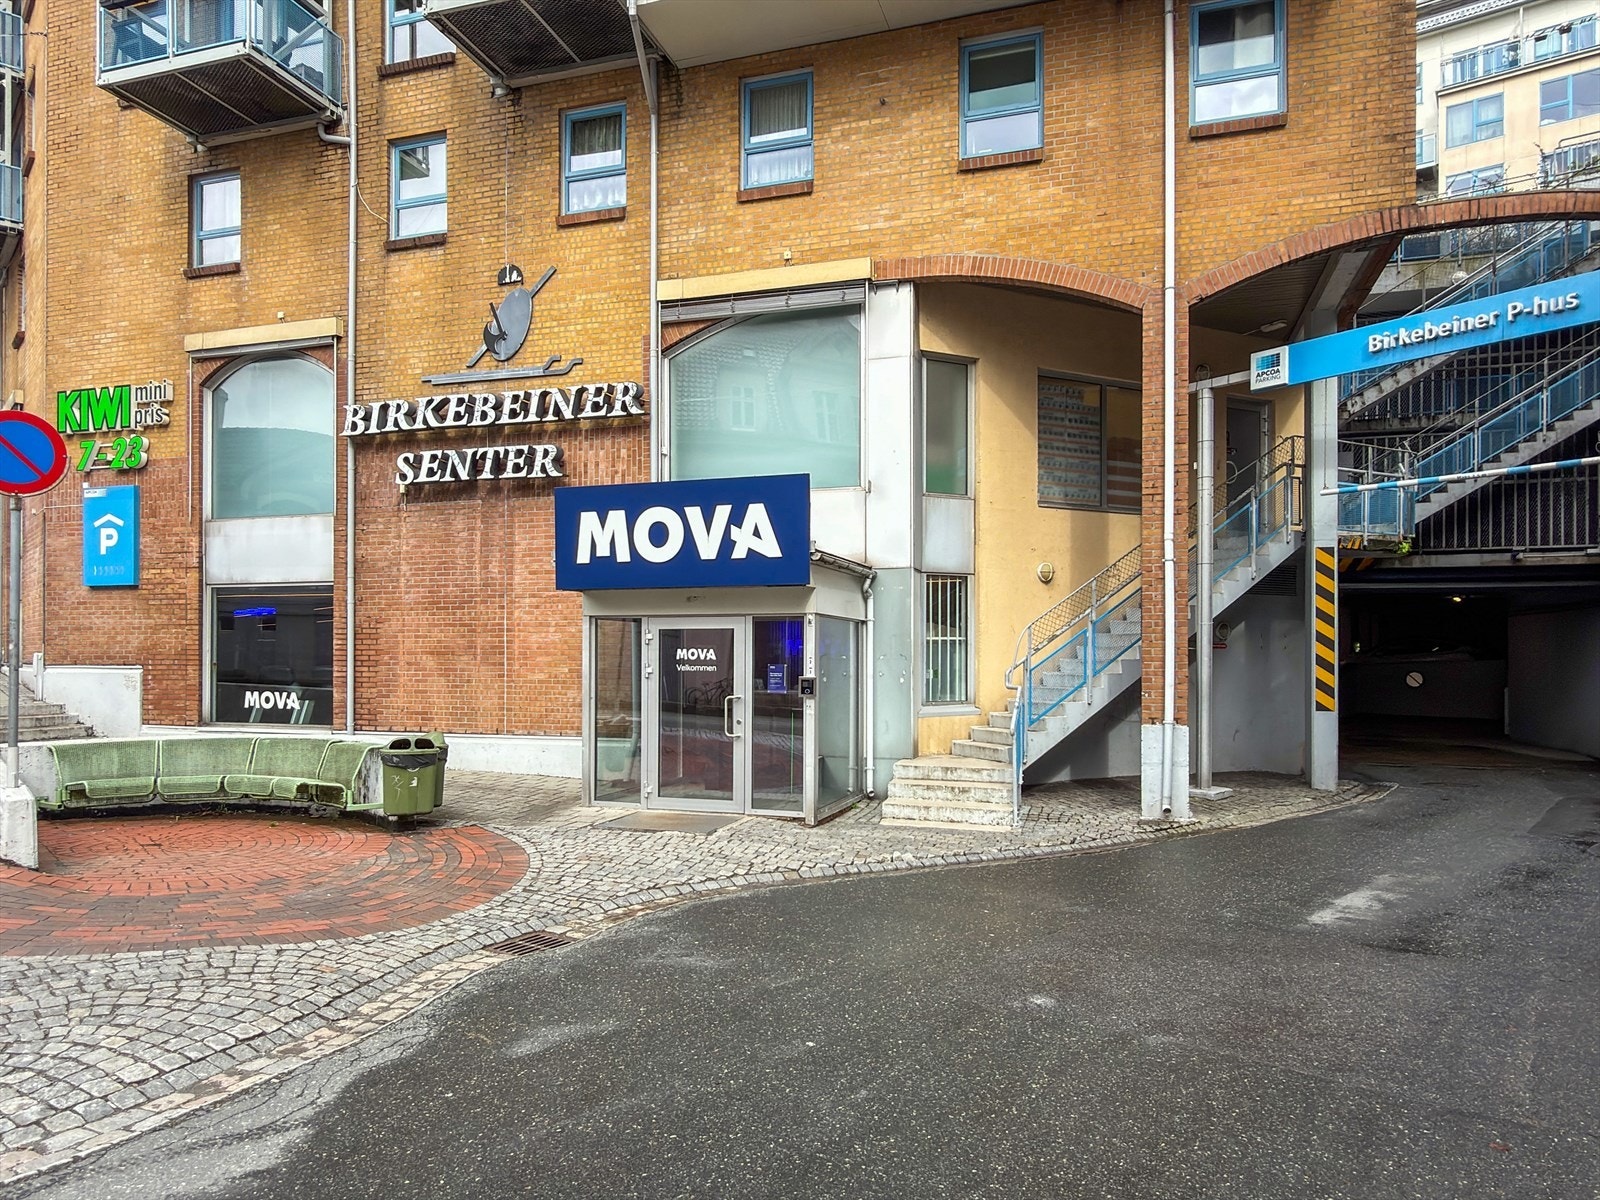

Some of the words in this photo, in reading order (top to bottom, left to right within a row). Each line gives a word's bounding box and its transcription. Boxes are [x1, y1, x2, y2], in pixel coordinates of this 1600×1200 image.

[1368, 310, 1501, 353] Birkebeiner
[1507, 292, 1580, 322] P-hus
[1255, 368, 1281, 378] APCOA
[1255, 374, 1281, 384] PARKING
[135, 379, 167, 401] mini
[57, 384, 132, 434] KIWI
[134, 404, 164, 429] pris
[339, 381, 645, 437] BIRKEBEINER
[394, 444, 565, 486] SENTER
[576, 502, 783, 565] MOVA
[676, 648, 717, 661] MOVA
[676, 663, 717, 672] Velkommen
[243, 691, 300, 710] MOVA
